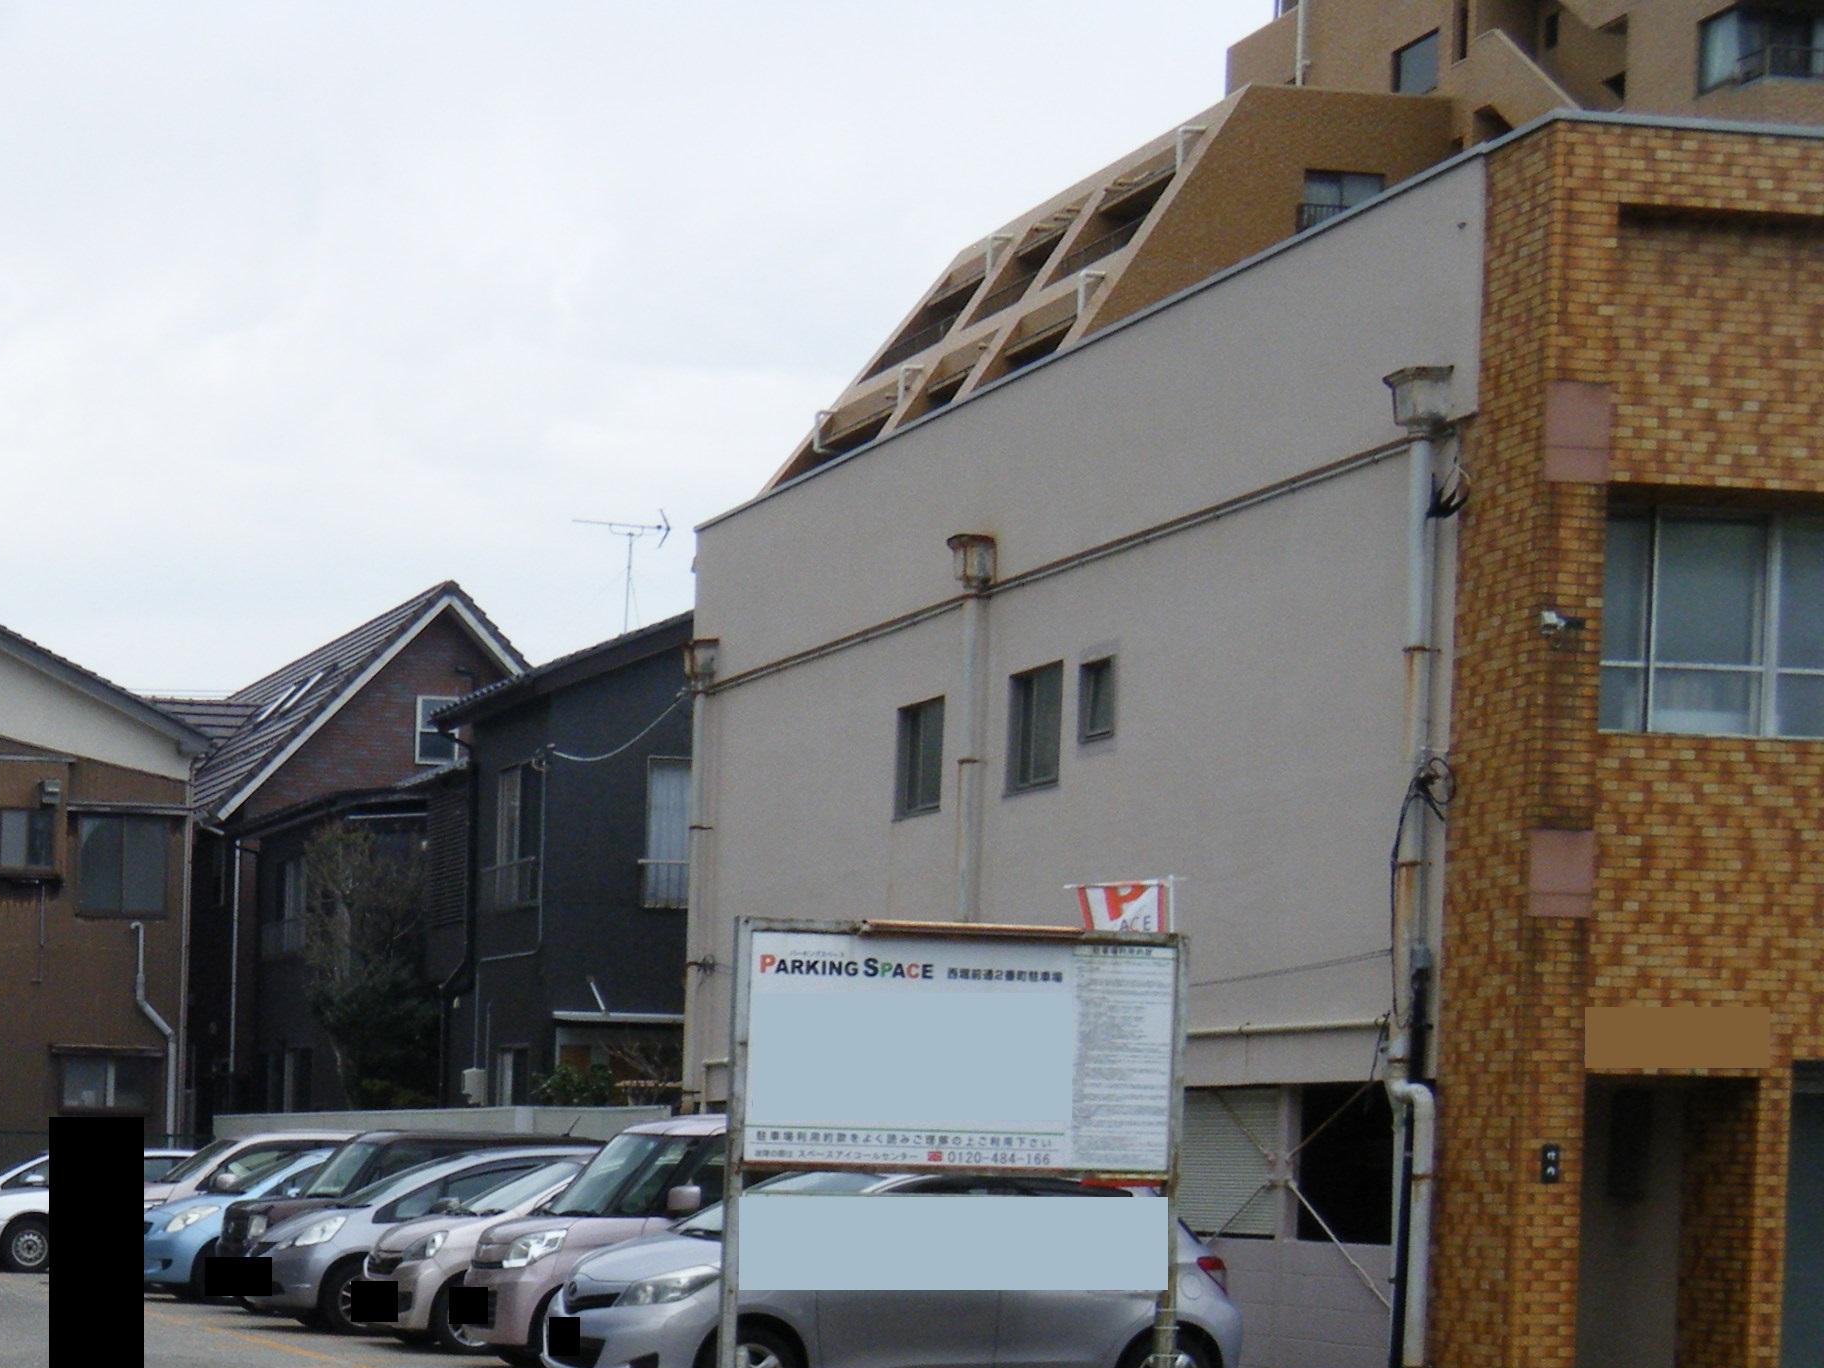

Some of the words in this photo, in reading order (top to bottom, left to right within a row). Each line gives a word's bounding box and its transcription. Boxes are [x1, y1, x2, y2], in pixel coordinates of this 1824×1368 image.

[1104, 884, 1147, 921] P
[760, 954, 858, 976] PARKING
[863, 957, 934, 979] SPACE
